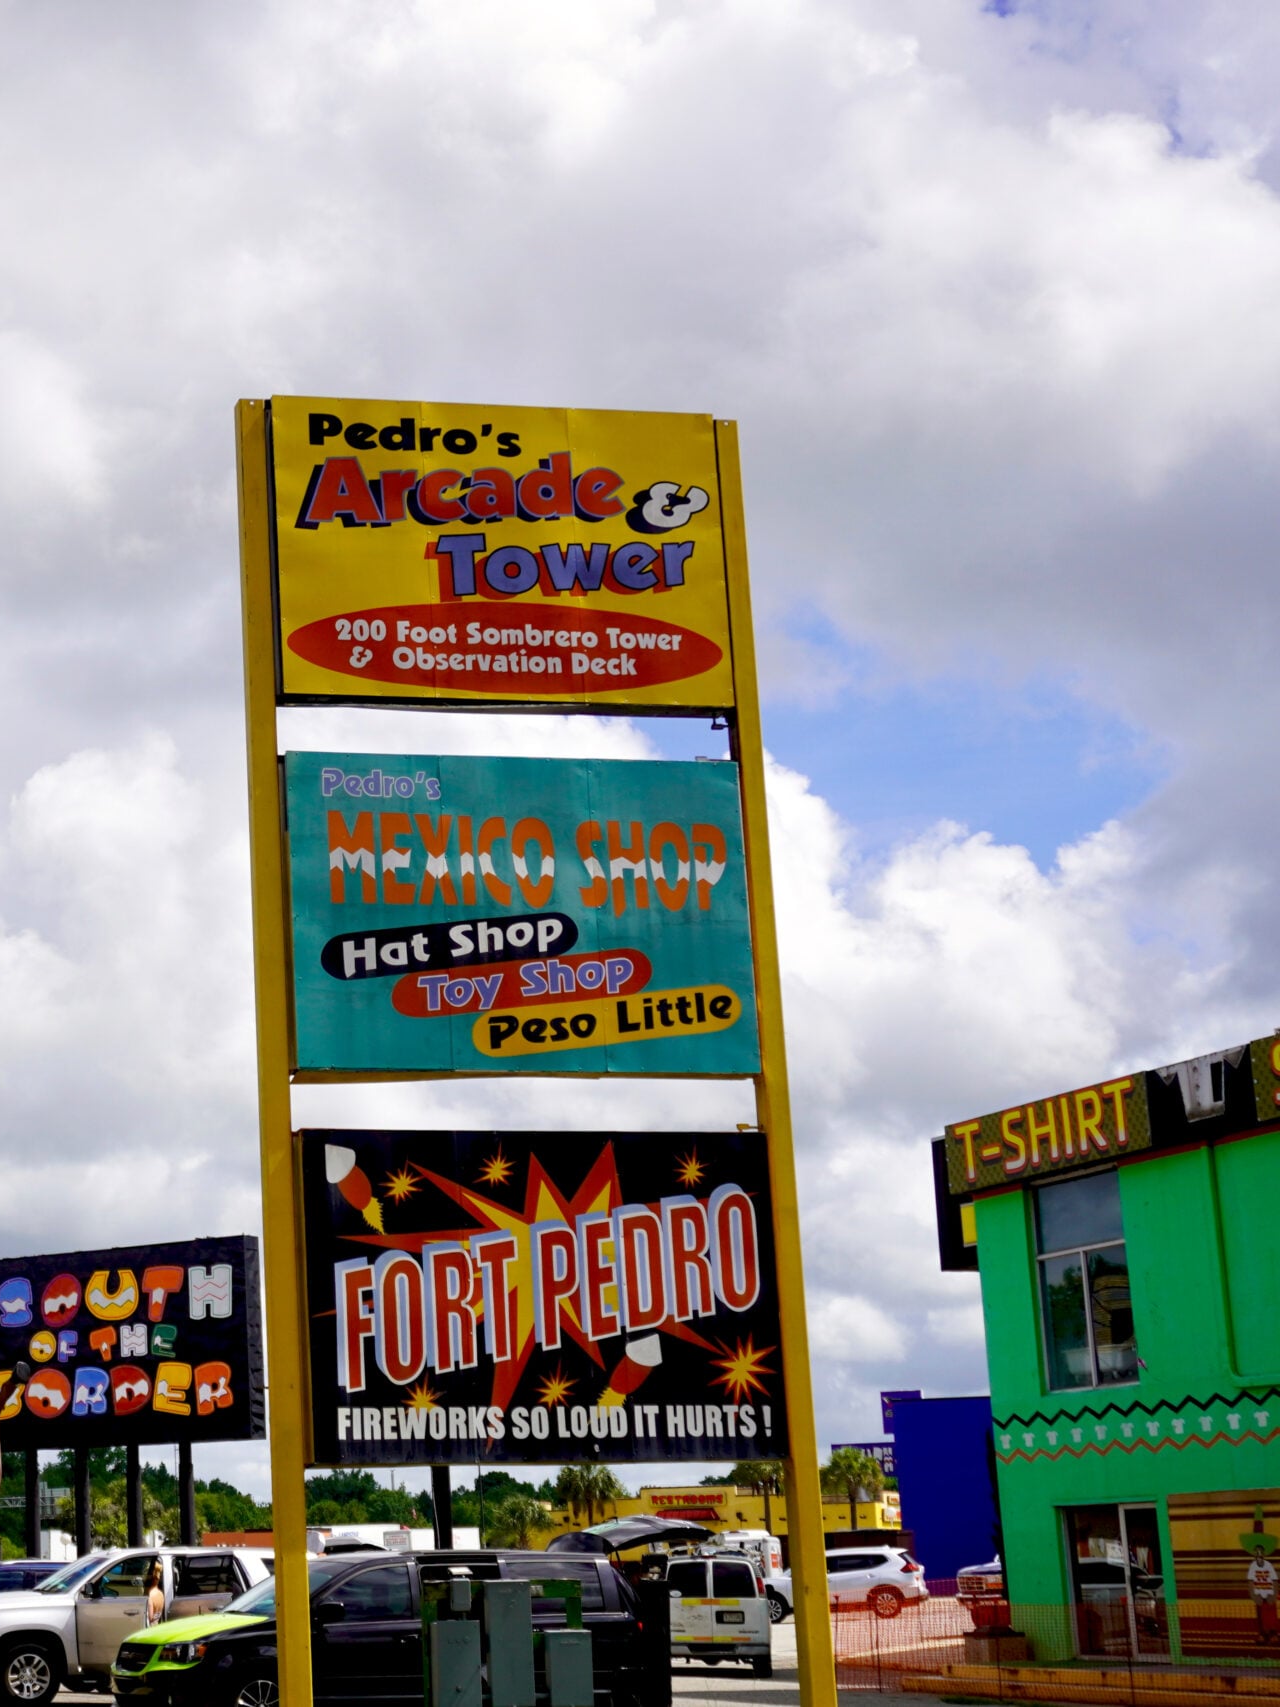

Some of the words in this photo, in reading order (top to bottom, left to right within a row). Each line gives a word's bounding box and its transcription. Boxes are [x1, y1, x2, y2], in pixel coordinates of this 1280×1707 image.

[308, 412, 522, 457] Pedro's
[301, 451, 627, 525] Arcade
[634, 481, 710, 532] &
[431, 532, 696, 599] Tower
[334, 618, 387, 643] 200
[397, 620, 457, 645] Foot
[466, 622, 599, 650] Sombrero
[606, 627, 683, 653] Tower
[348, 646, 373, 669] &
[392, 646, 563, 675] Observation
[572, 650, 638, 677] Deck
[320, 767, 442, 801] Pedro's
[326, 809, 556, 910] MEXICO
[575, 819, 728, 919] SHOP
[342, 931, 431, 979] Hat
[448, 918, 565, 959] Shop
[417, 972, 505, 1012] Toy
[520, 956, 635, 998] Shop
[487, 1012, 598, 1050] Peso
[616, 992, 734, 1034] Little
[952, 1075, 1134, 1184] T-SHIRT
[335, 1228, 519, 1394] FORT
[530, 1183, 761, 1352] PEDRO
[28, 1330, 78, 1363] OF
[89, 1323, 178, 1363] THE
[337, 1405, 505, 1442] FIREWORKS
[512, 1406, 549, 1440] SO
[556, 1404, 628, 1440] LOUD
[634, 1404, 662, 1438] IT
[650, 1493, 724, 1505] RESTROOMS
